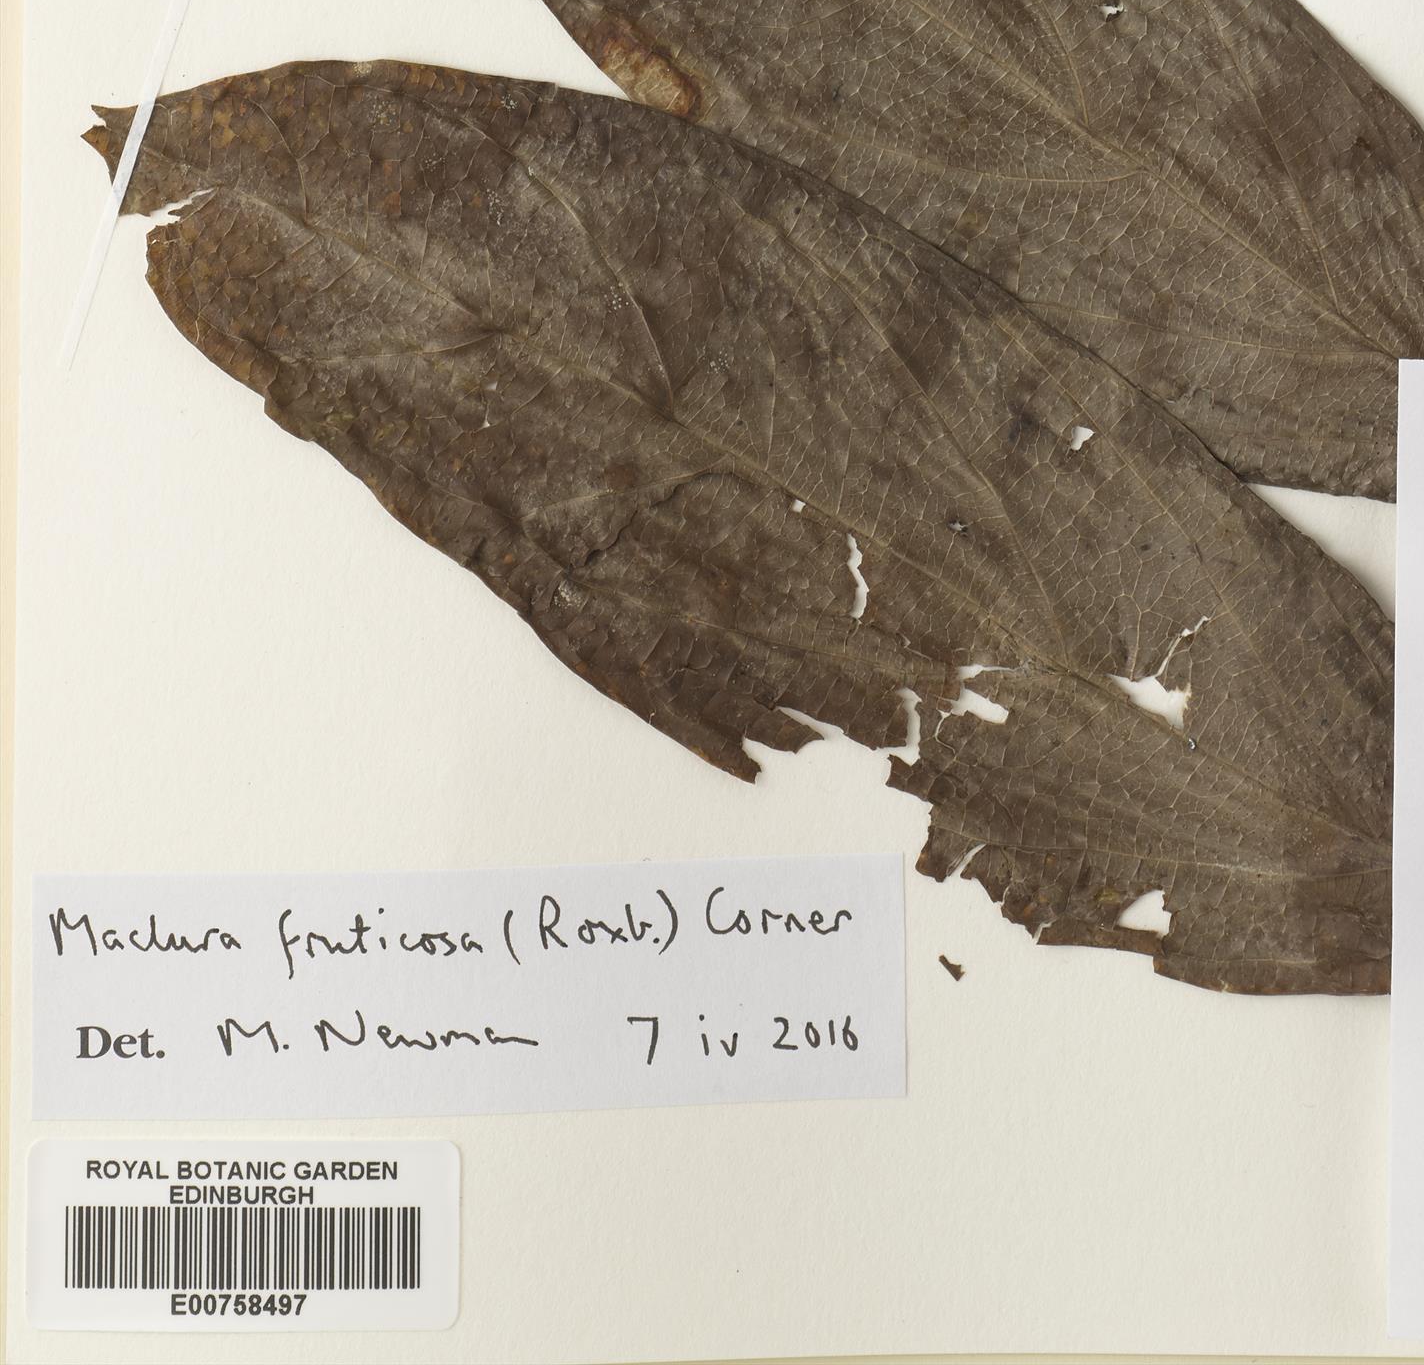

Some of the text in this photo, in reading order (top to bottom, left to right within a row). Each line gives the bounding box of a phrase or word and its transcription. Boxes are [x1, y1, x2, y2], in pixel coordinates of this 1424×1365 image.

[48, 886, 853, 980] Maclura fruticosa (Roxb.) Corner
[75, 1009, 859, 1066] Det. M. Newman 7 iv 2016
[86, 1160, 398, 1181] ROYAL BOTANIC GARDEN
[169, 1185, 314, 1205] EDINBURGH
[170, 1293, 308, 1316] E00758497
